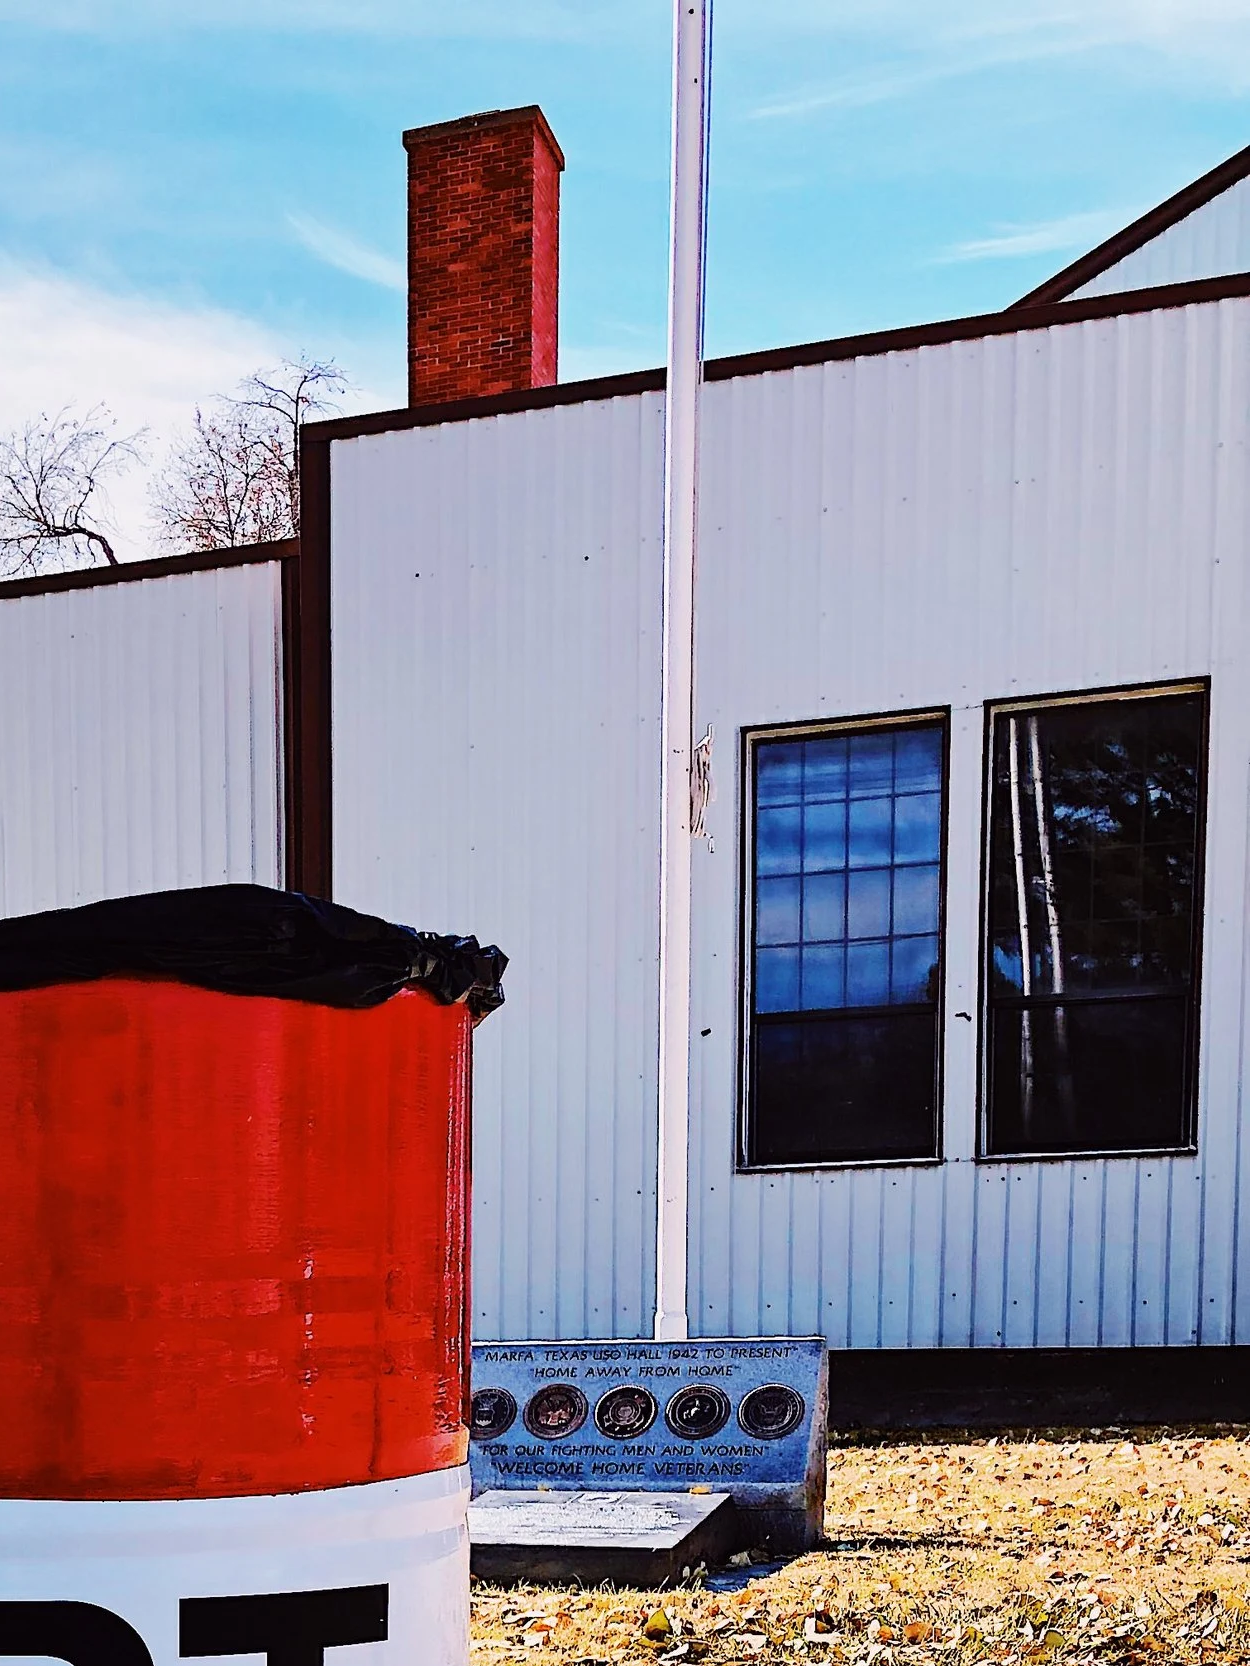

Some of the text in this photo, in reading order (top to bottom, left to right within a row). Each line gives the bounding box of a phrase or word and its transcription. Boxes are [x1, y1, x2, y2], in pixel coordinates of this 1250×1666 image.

[484, 1350, 534, 1362] MARFA
[544, 1350, 588, 1361] TEXAS
[592, 1349, 622, 1360] USO
[626, 1349, 662, 1360] HALL
[668, 1349, 699, 1359] 1942
[706, 1349, 725, 1359] TO
[585, 1367, 632, 1377] AWAY
[638, 1365, 681, 1377] FROM
[514, 1444, 545, 1457] OUR
[551, 1444, 616, 1456] FIGHTING
[622, 1445, 656, 1456] MEN
[661, 1445, 695, 1456] AND
[591, 1461, 646, 1475] HOME
